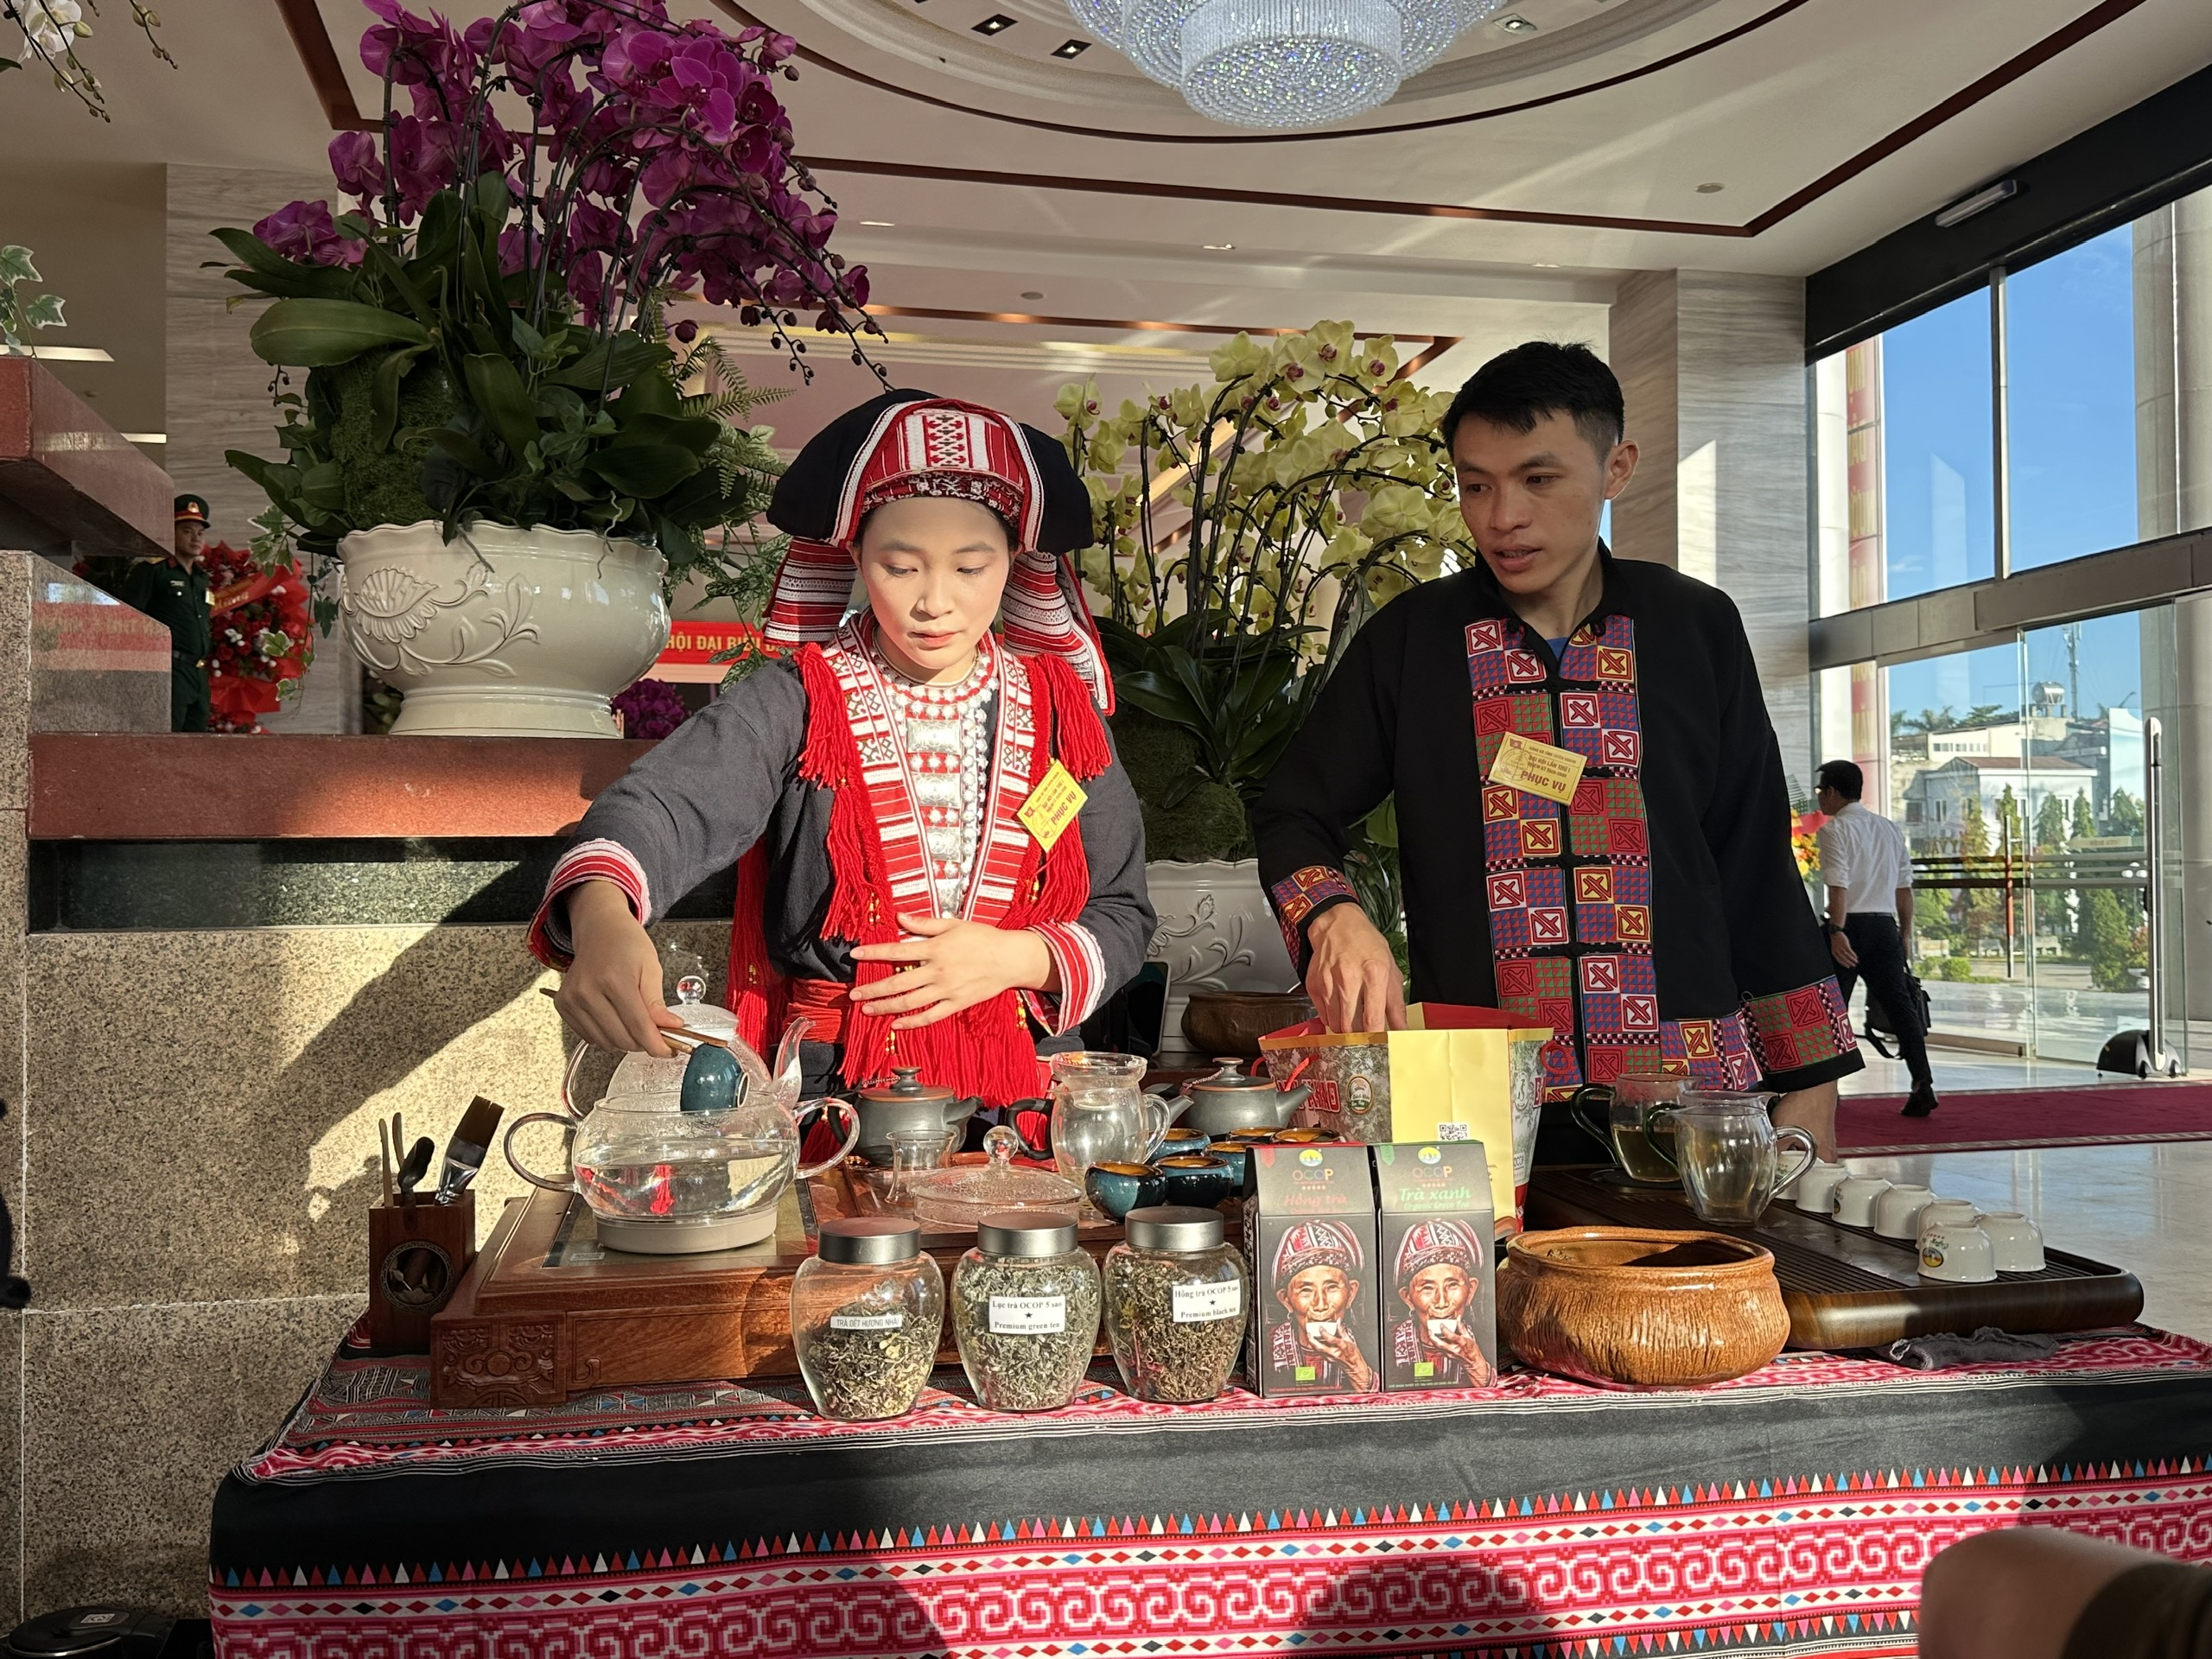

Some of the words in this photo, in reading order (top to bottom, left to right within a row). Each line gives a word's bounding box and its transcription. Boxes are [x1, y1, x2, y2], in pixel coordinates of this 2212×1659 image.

[665, 632, 691, 652] HỘI
[696, 635, 723, 652] ĐẠI
[1520, 771, 1549, 786] PHỤC
[1552, 780, 1566, 793] VỤ
[1051, 802, 1068, 824] PHỤC
[1066, 791, 1076, 804] VỤ
[1293, 1168, 1334, 1181] OCOP
[1412, 1166, 1452, 1179] OCOP
[1325, 1194, 1347, 1204] trà
[1400, 1186, 1425, 1201] Trà
[1429, 1185, 1471, 1199] xanh
[1175, 1288, 1194, 1299] Hồng
[1207, 1287, 1226, 1295] OCOP
[993, 1300, 1006, 1309] Lục
[1007, 1300, 1018, 1309] trà
[1213, 1307, 1228, 1316] black
[836, 1319, 849, 1327] TRÀ
[995, 1321, 1027, 1330] Premium
